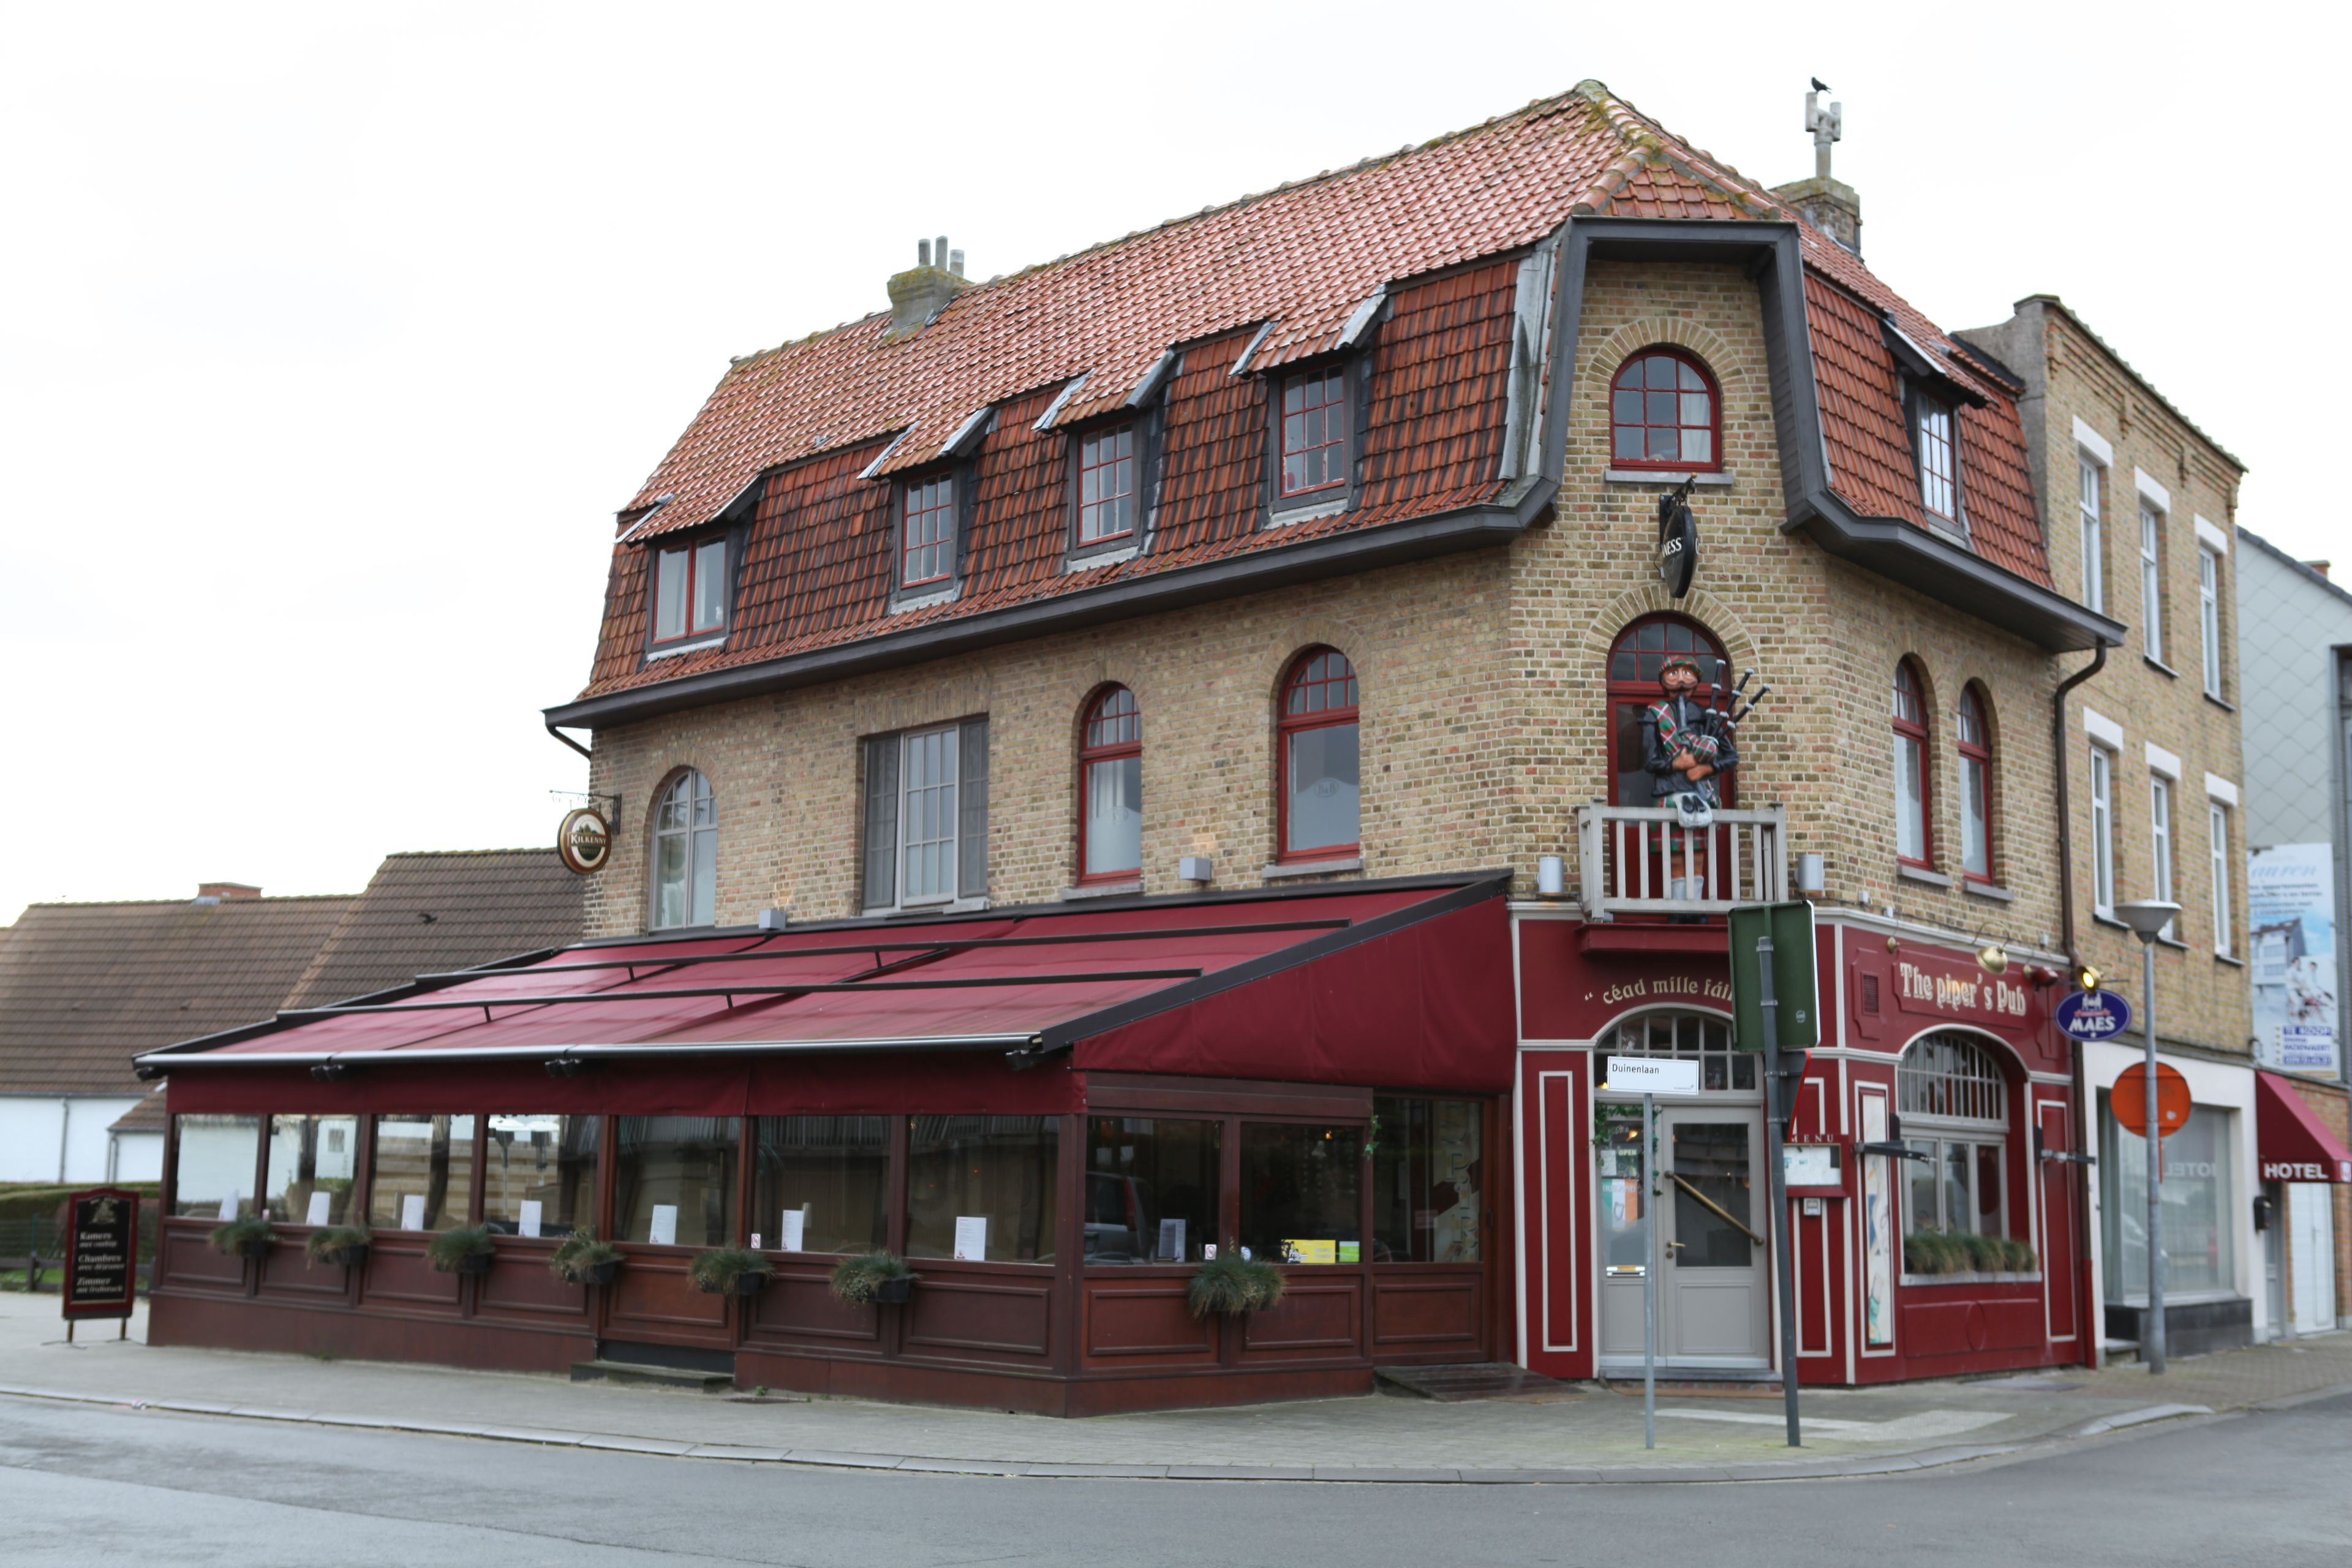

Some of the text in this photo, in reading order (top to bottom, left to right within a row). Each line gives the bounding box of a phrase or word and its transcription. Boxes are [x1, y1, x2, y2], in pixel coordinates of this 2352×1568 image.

[571, 834, 606, 845] KILKENNY
[1603, 978, 1646, 1005] céad
[1653, 976, 1698, 994] mille
[1900, 962, 1934, 1000] The
[1997, 980, 2027, 1016] Pub
[2068, 1016, 2116, 1032] MAES
[1612, 1063, 1659, 1074] Duinenlaan
[1791, 1134, 1834, 1142] MENU
[2264, 1163, 2329, 1178] HOTEL
[78, 1254, 122, 1263] Chambres
[77, 1277, 111, 1286] Zimmer
